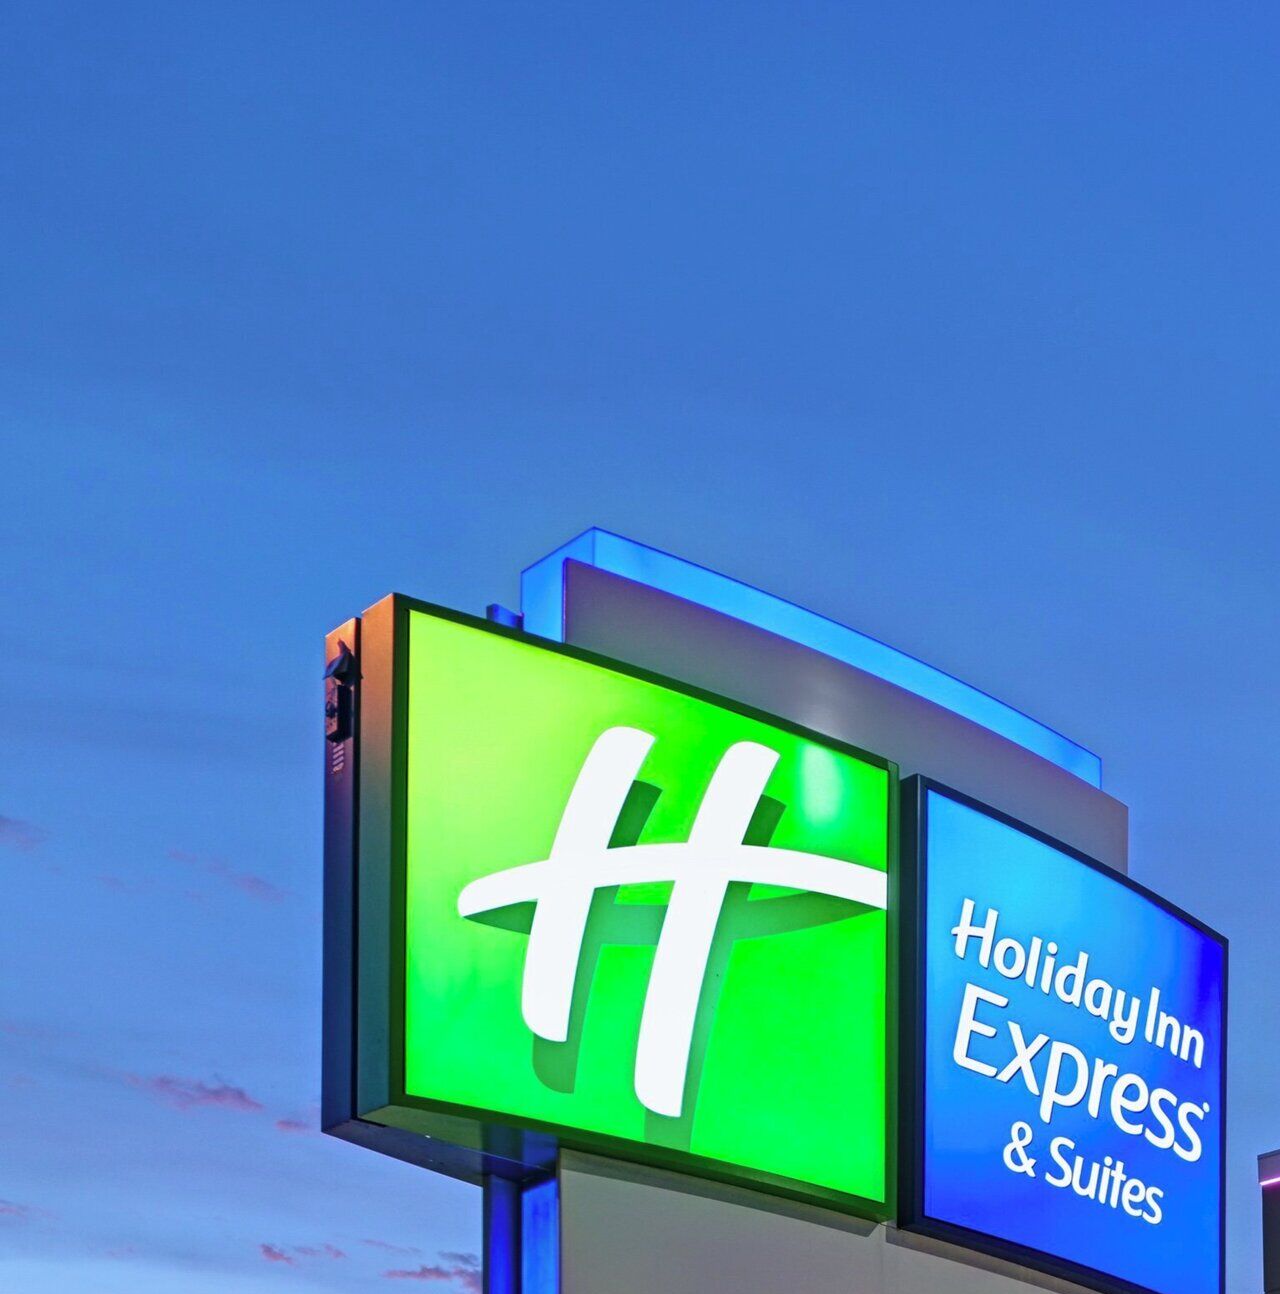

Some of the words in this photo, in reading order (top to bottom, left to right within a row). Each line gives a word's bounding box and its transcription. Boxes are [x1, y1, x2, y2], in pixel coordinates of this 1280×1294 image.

[951, 897, 1140, 1044] Holiday
[1144, 986, 1204, 1069] Inn
[953, 982, 1204, 1162] Express
[1002, 1120, 1037, 1178] &
[1045, 1136, 1164, 1225] Suites
